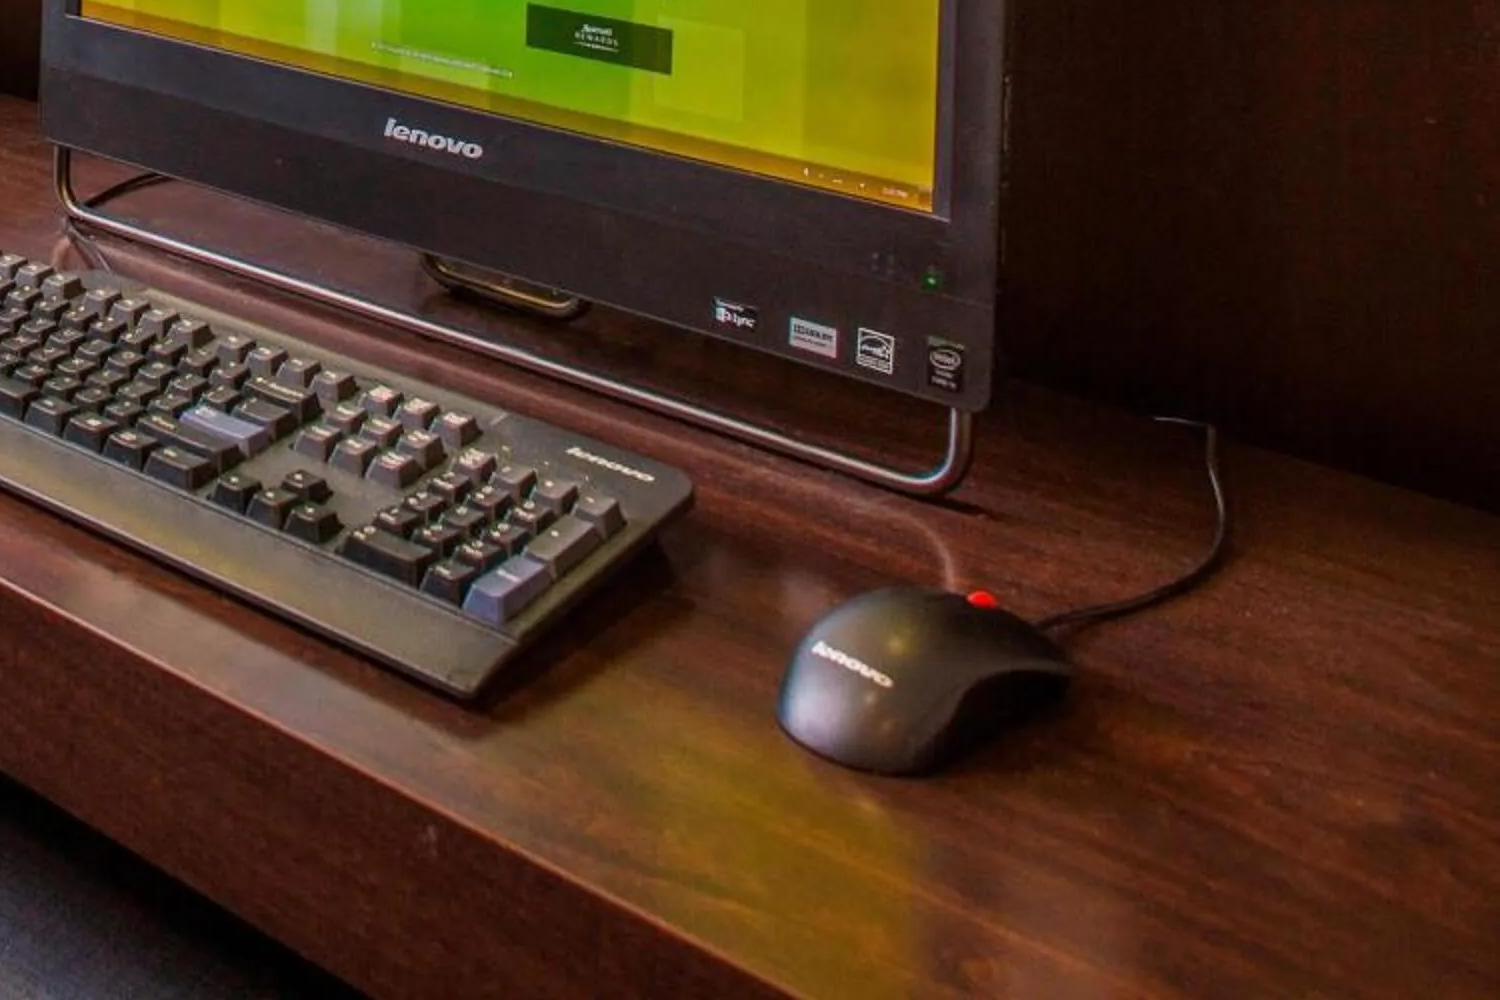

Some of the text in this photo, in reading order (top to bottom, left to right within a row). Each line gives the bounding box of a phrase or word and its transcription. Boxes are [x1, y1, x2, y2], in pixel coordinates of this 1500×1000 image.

[383, 117, 484, 160] lenovo
[565, 446, 656, 484] lenovo
[811, 639, 895, 690] lenovo
